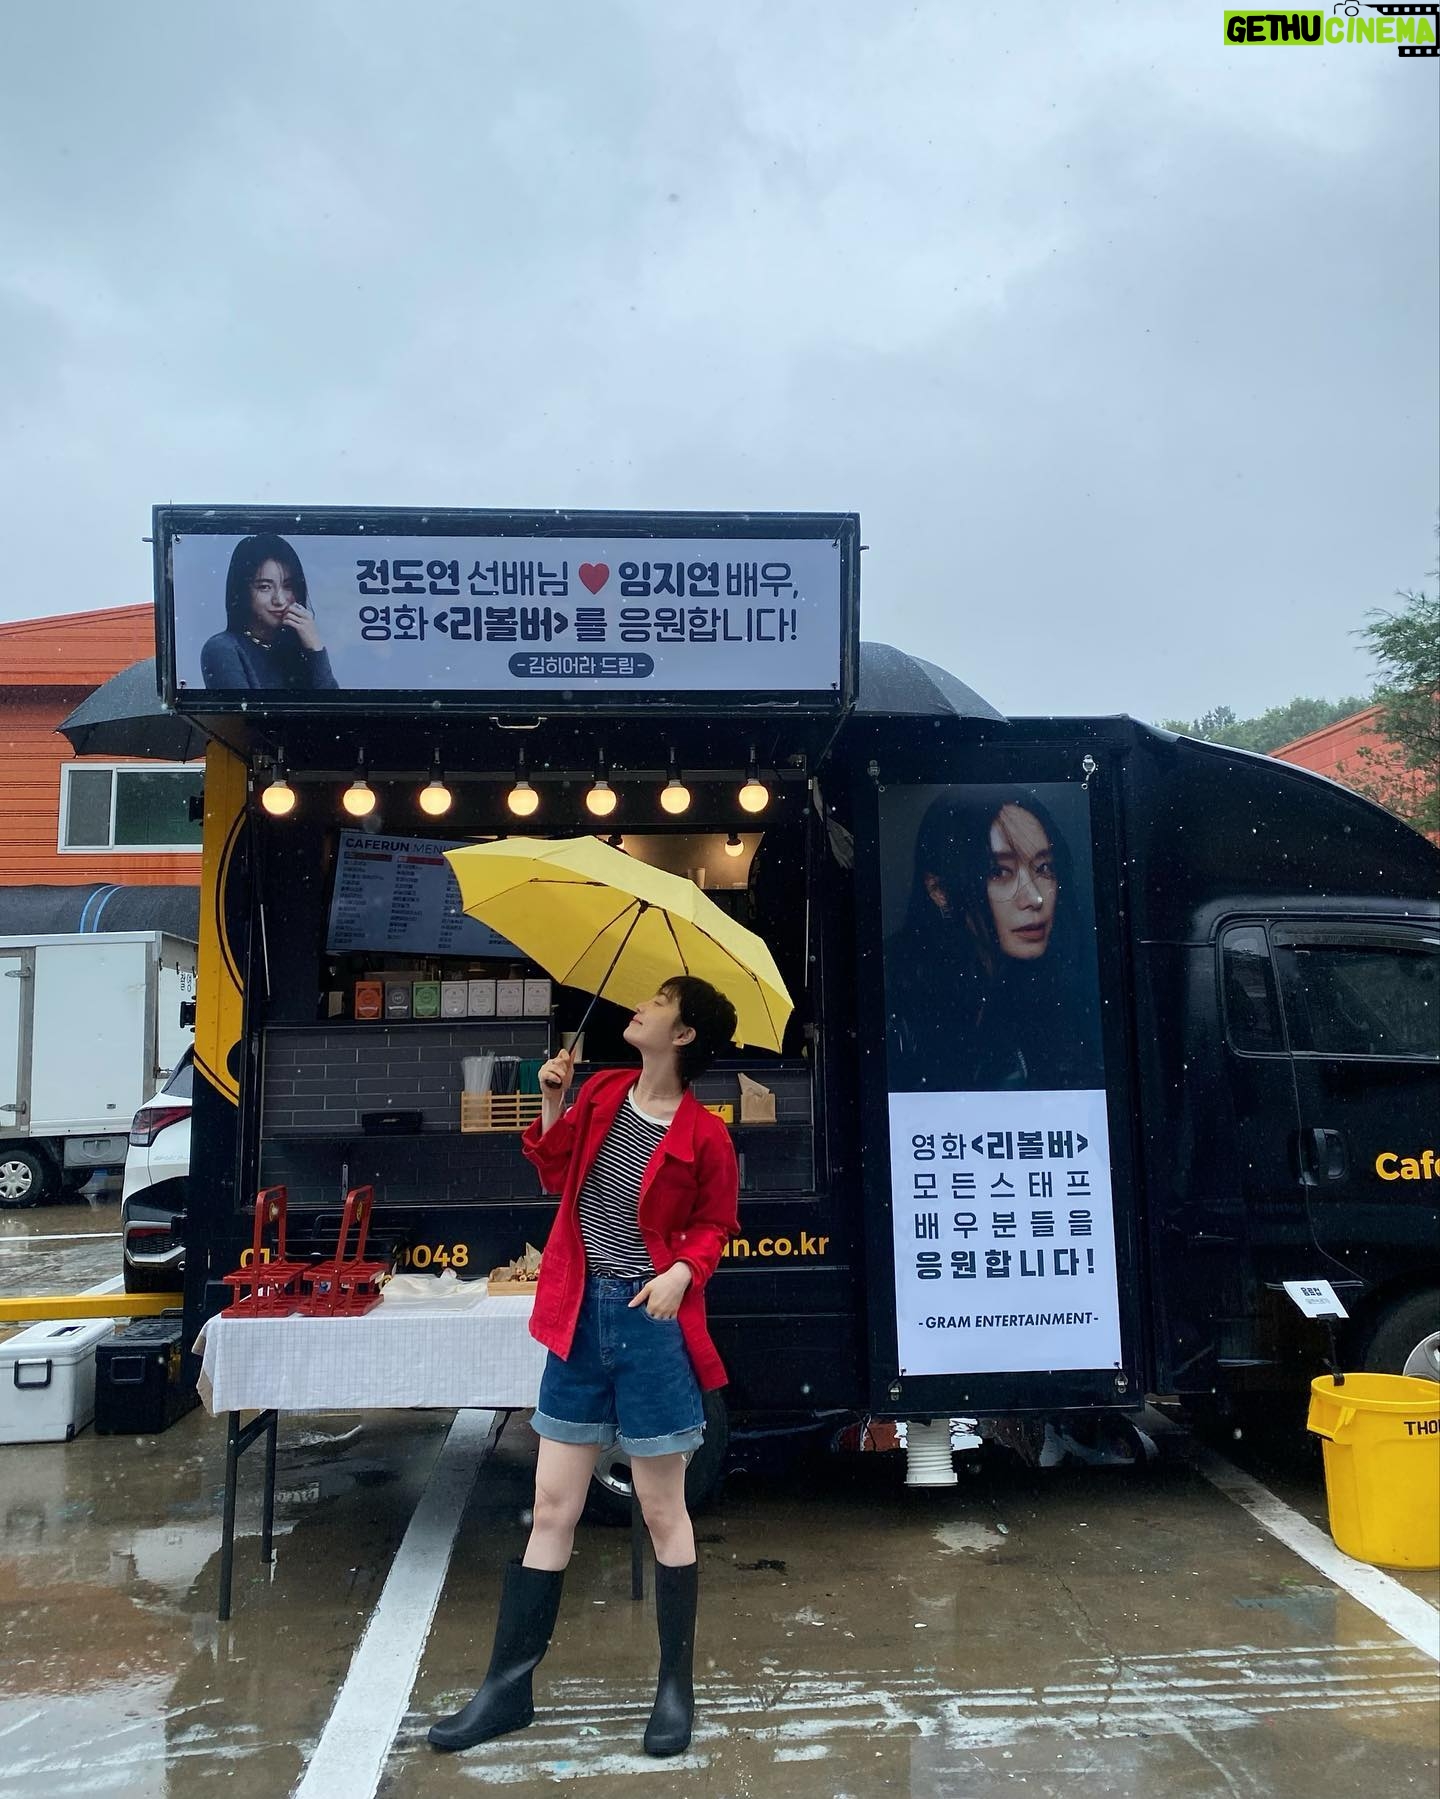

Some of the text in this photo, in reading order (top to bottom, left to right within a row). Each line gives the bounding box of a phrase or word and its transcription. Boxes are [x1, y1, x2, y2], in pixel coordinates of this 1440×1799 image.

[356, 559, 799, 599] 전도연 선배님 임지연 배우,
[618, 606, 798, 643] 응원합니다!
[345, 838, 410, 853] CAFERUN
[1375, 1149, 1440, 1181] Caf
[405, 1244, 468, 1268] 048
[915, 1248, 1095, 1281] 응원합니다!
[1403, 1419, 1440, 1436] THO
